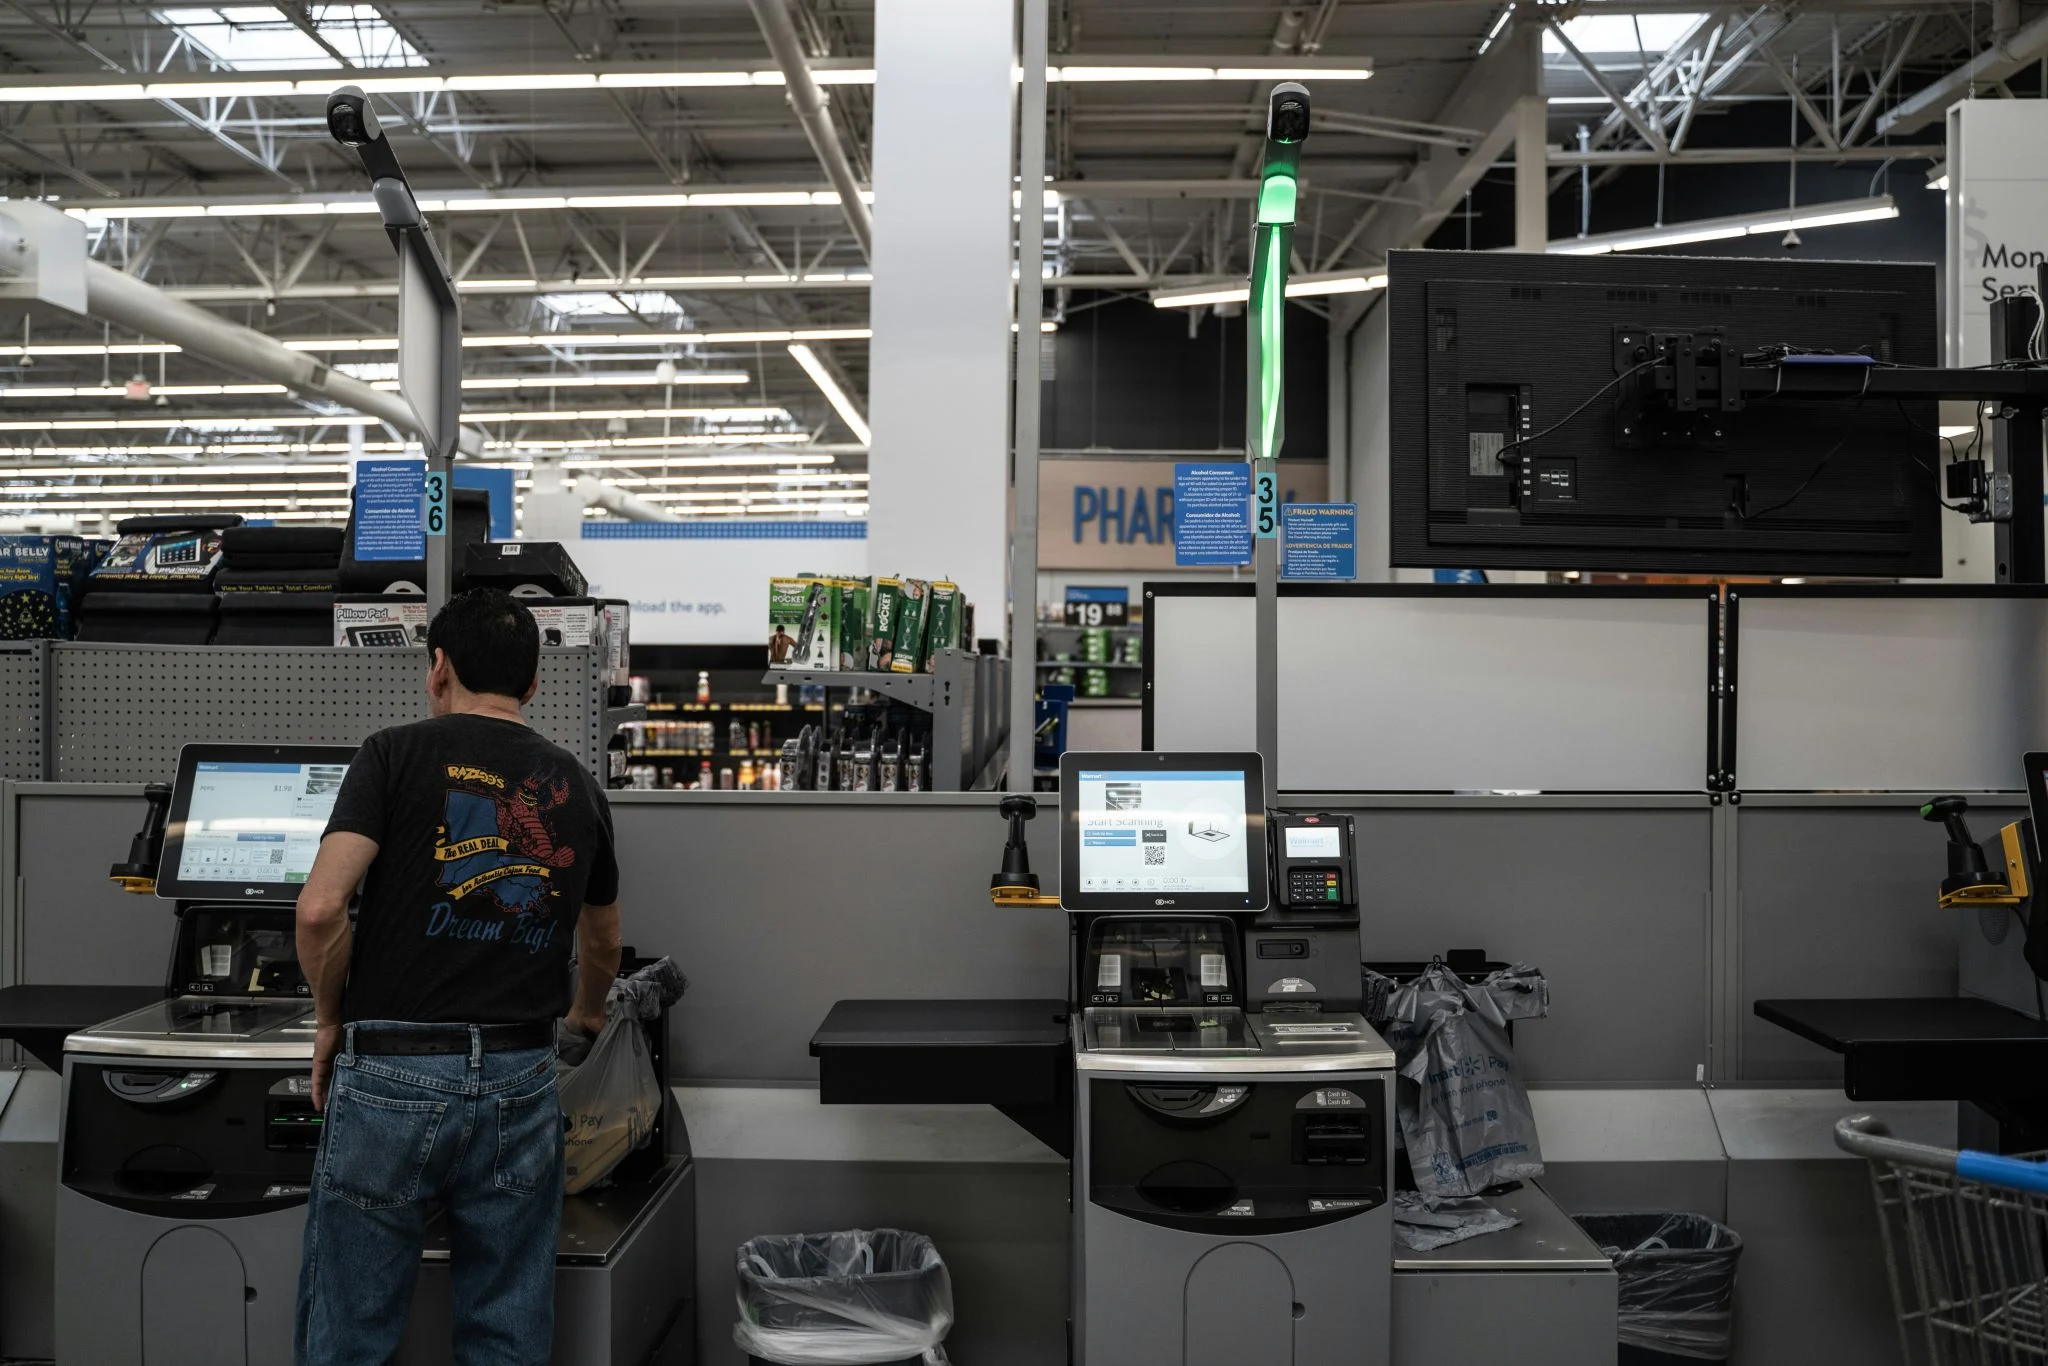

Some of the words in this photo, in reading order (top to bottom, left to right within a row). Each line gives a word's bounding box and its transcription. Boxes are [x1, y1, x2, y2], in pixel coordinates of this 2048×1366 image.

[15, 547, 49, 556] BELLY
[773, 594, 805, 603] ROCKET
[336, 608, 366, 619] Pillow
[368, 608, 388, 619] Pad
[880, 593, 892, 632] ROCKET
[1088, 817, 1112, 826] Start
[1116, 816, 1164, 828] Scanning
[459, 842, 480, 856] REAL
[481, 838, 500, 851] DEAL
[426, 902, 504, 941] Dream
[1476, 1078, 1506, 1090] phone
[580, 1113, 603, 1129] Pay
